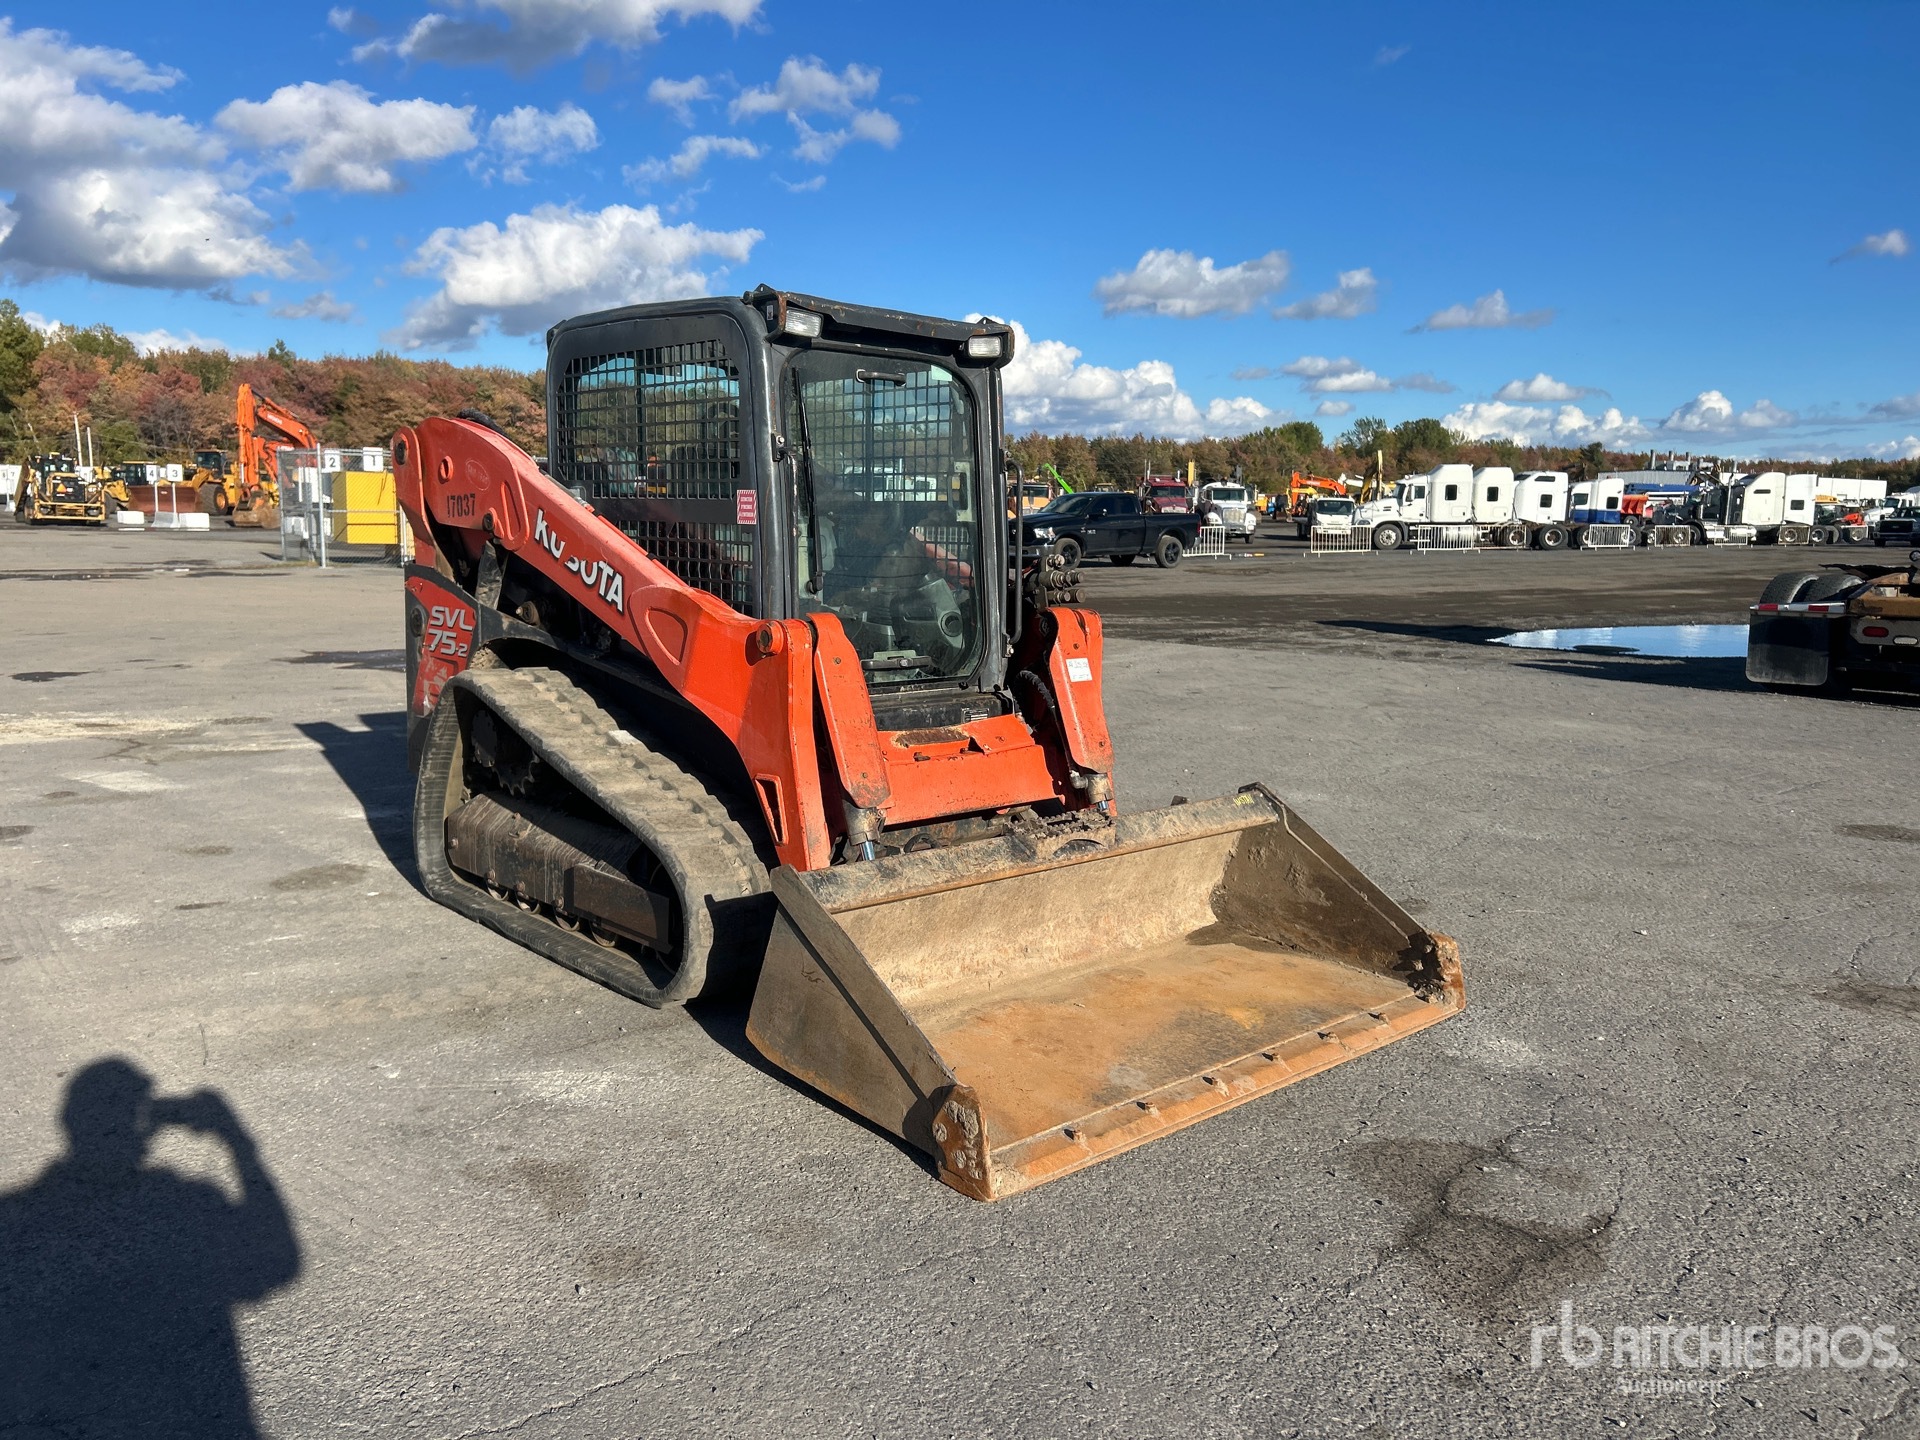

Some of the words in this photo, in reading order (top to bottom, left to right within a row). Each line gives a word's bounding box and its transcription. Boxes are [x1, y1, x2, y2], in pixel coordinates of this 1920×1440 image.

[329, 456, 336, 468] 2
[149, 469, 155, 478] 4
[172, 469, 178, 478] 3
[446, 493, 476, 519] 17037
[429, 605, 474, 632] SVL
